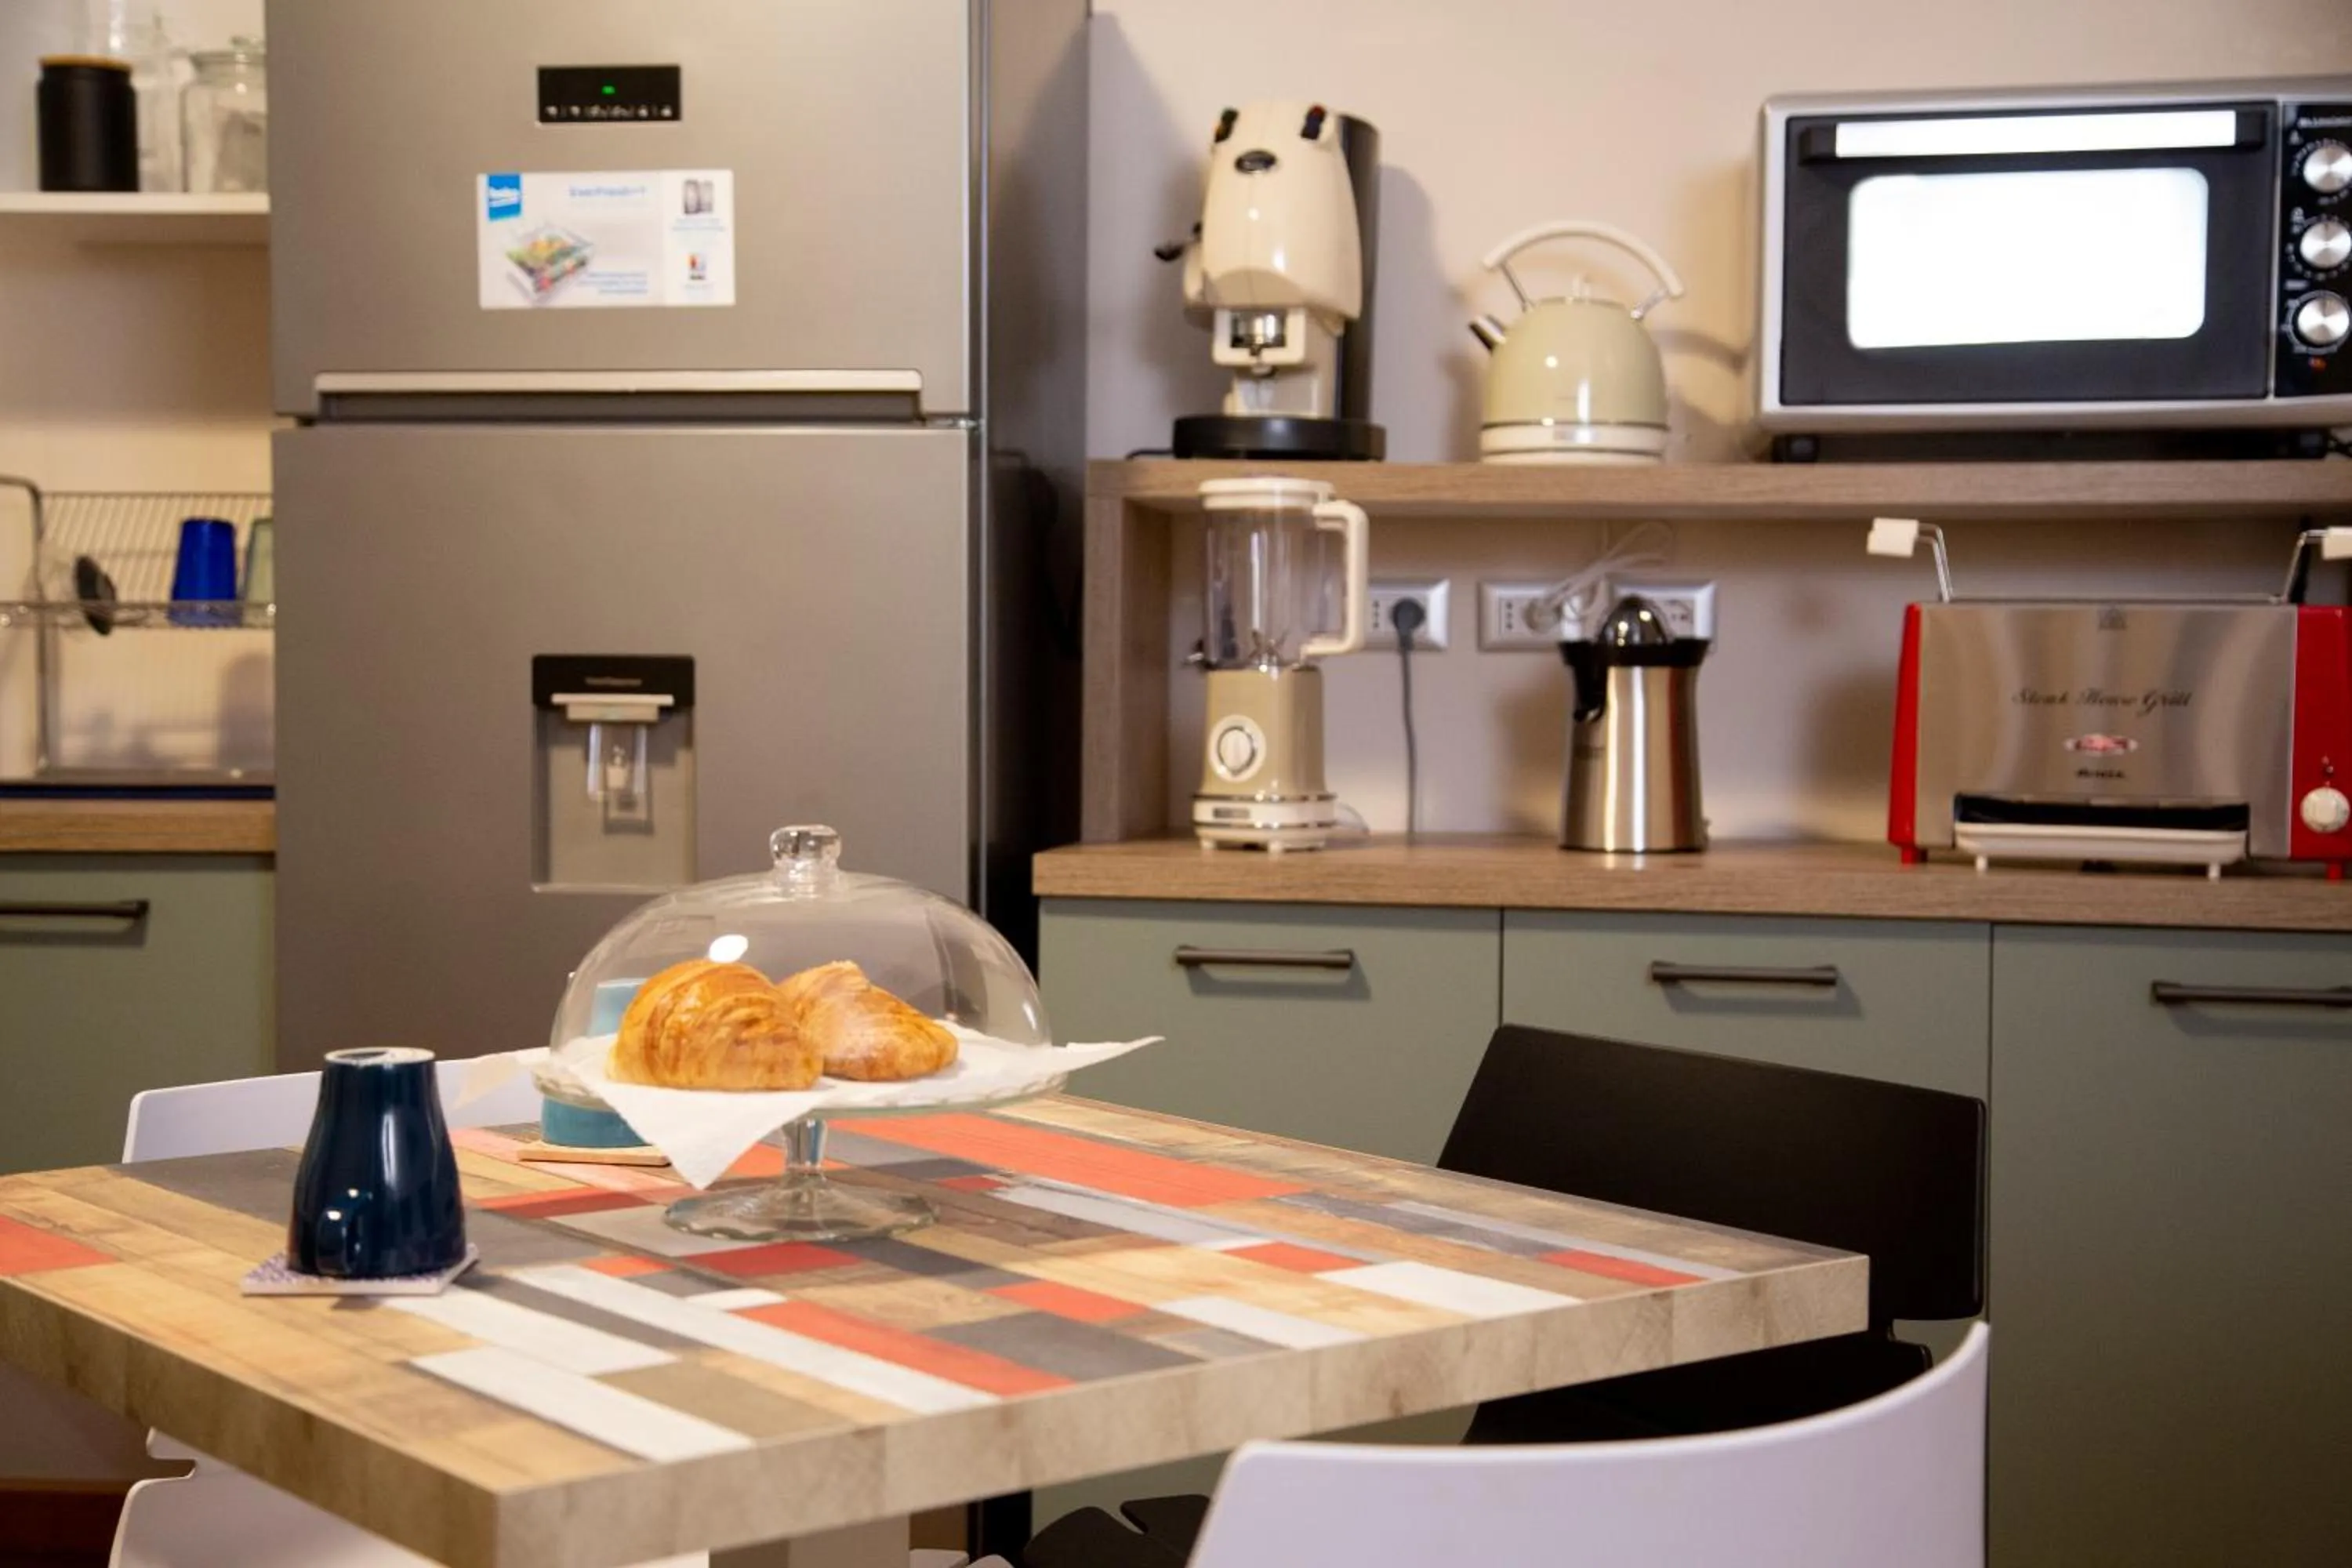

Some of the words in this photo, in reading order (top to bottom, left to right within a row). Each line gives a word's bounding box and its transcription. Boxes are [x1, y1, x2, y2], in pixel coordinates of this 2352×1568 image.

[2011, 688, 2068, 706] Steak
[2078, 688, 2138, 706] House
[2136, 689, 2193, 717] Grill
